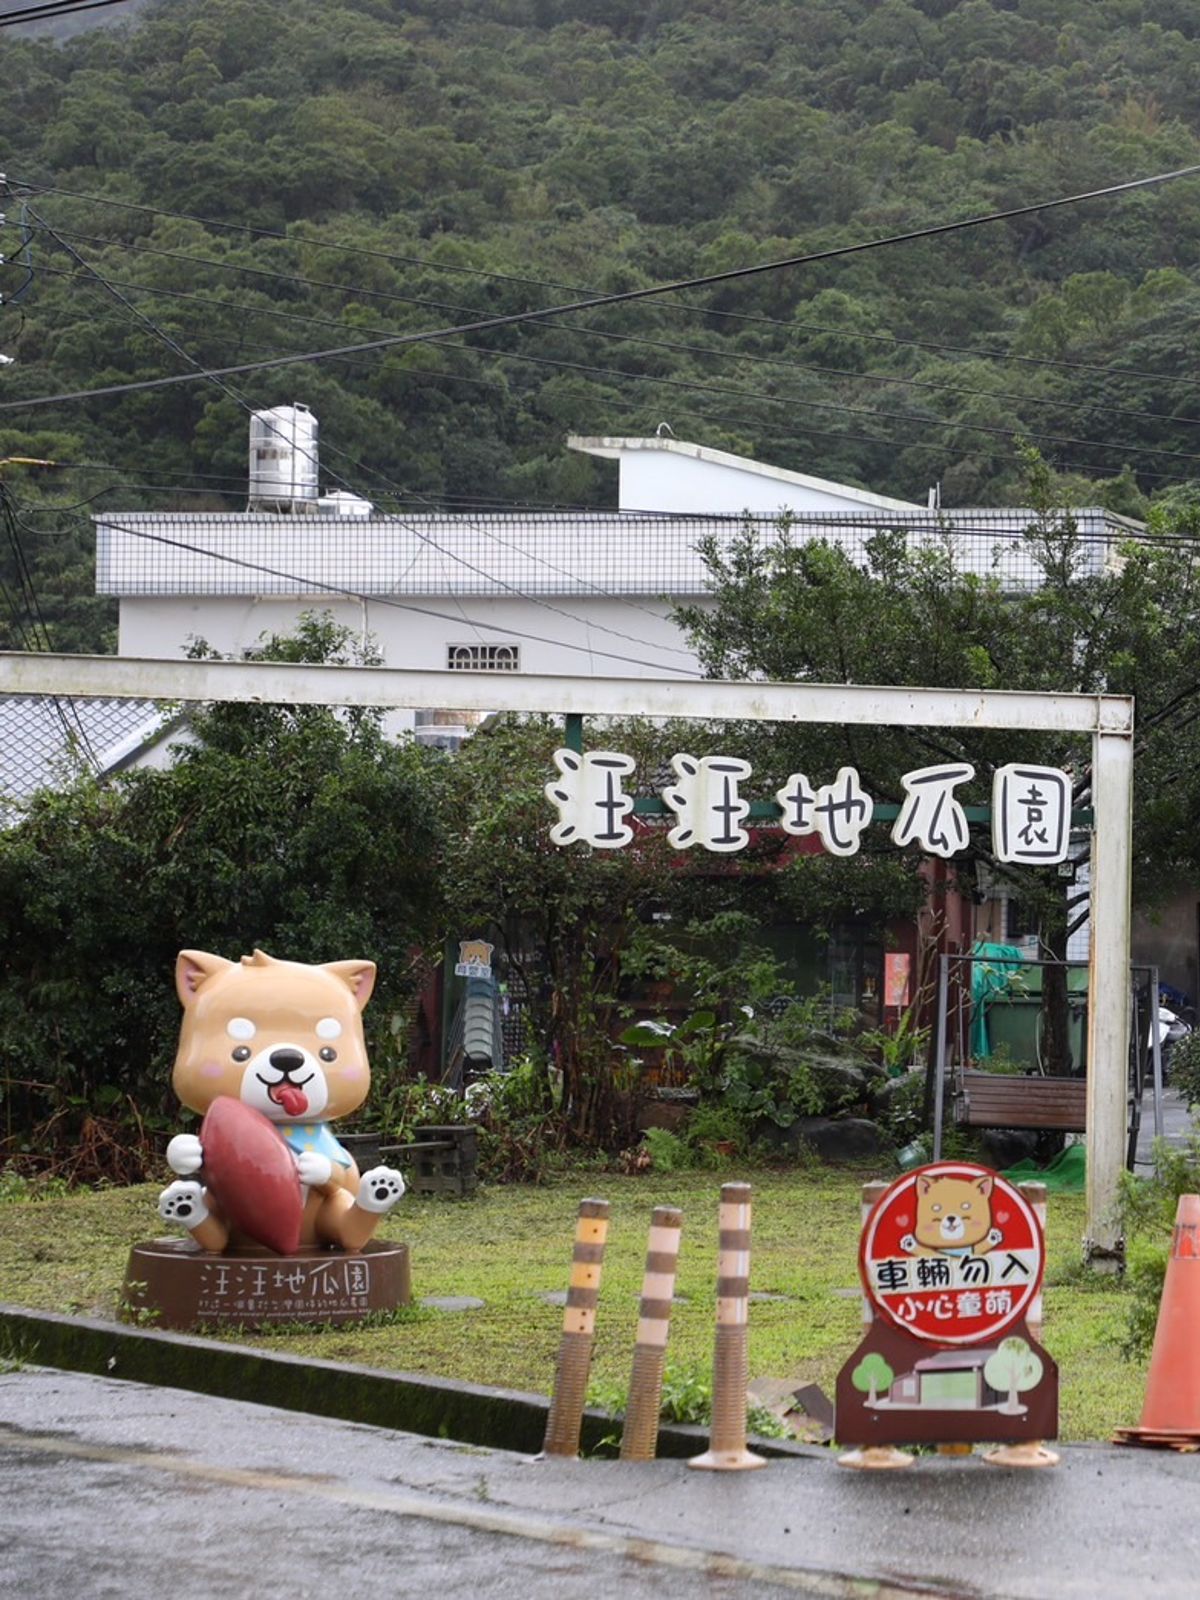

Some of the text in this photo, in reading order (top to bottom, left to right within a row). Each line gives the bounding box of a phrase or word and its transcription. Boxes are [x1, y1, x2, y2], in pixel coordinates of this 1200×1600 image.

[545, 748, 1072, 864] 汪汪地瓜園
[200, 1259, 370, 1296] 汪汪地瓜園
[876, 1253, 1030, 1290] 車輛勿入
[897, 1290, 1013, 1320] 小心童萌
